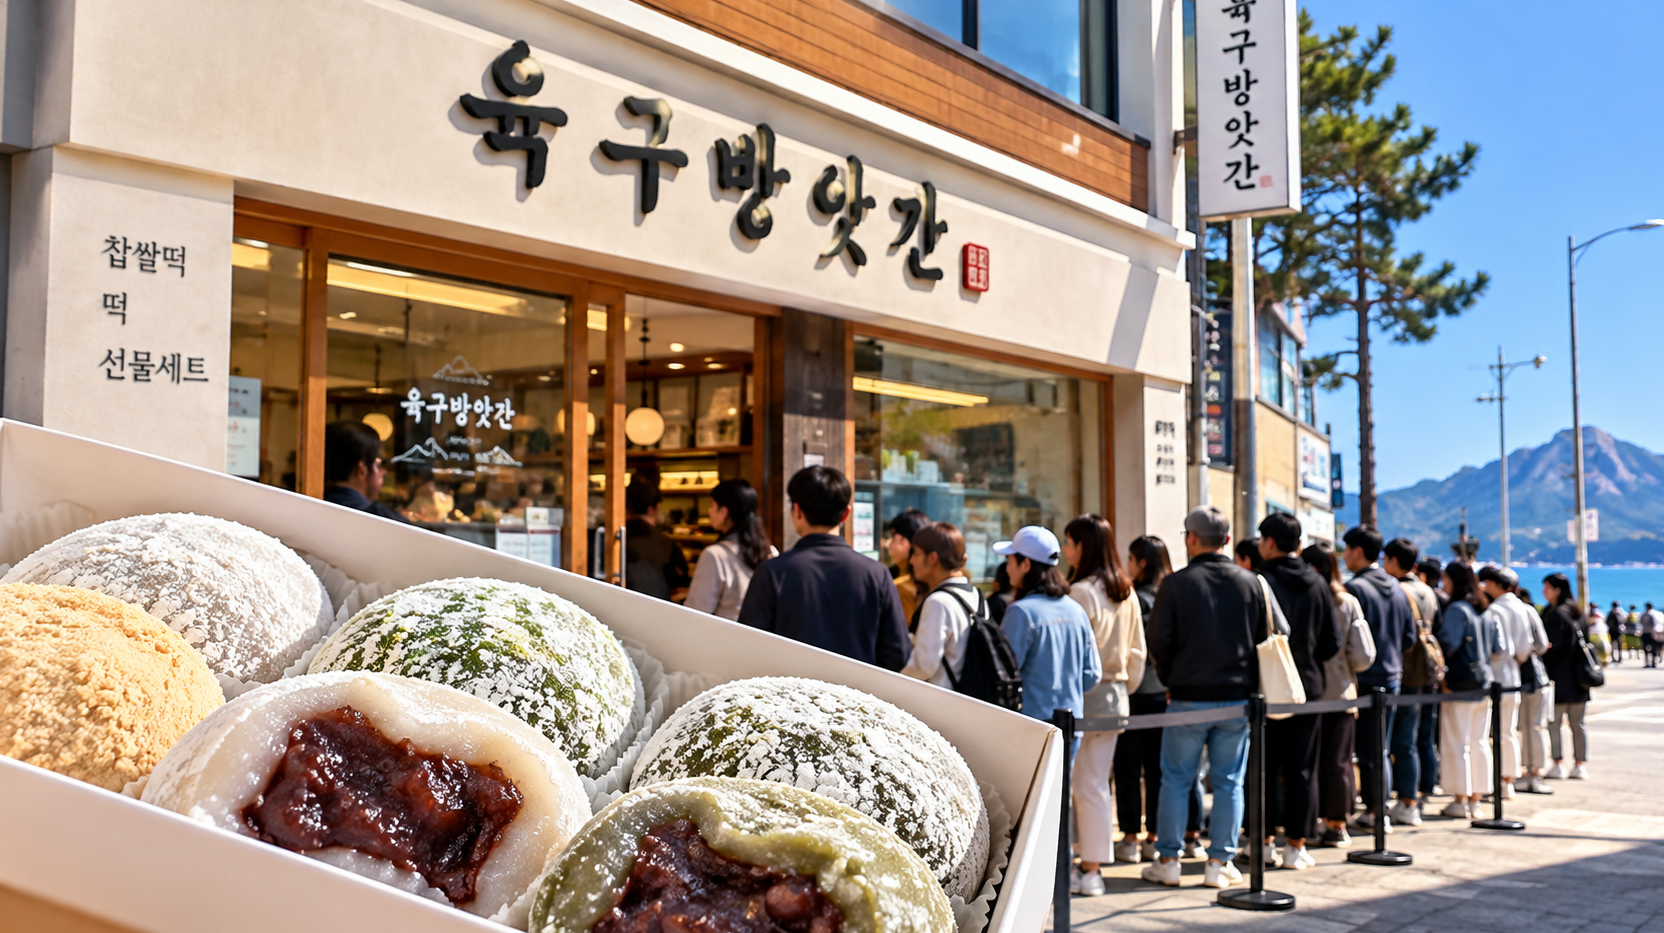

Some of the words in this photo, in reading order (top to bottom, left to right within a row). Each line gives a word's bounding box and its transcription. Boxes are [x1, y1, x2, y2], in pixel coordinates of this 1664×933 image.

[460, 39, 948, 281] 육구방앗간
[102, 235, 186, 278] 찹쌀떡
[102, 292, 128, 326] 떡
[99, 348, 209, 385] 선물세트
[400, 386, 516, 430] 육구방앗간
